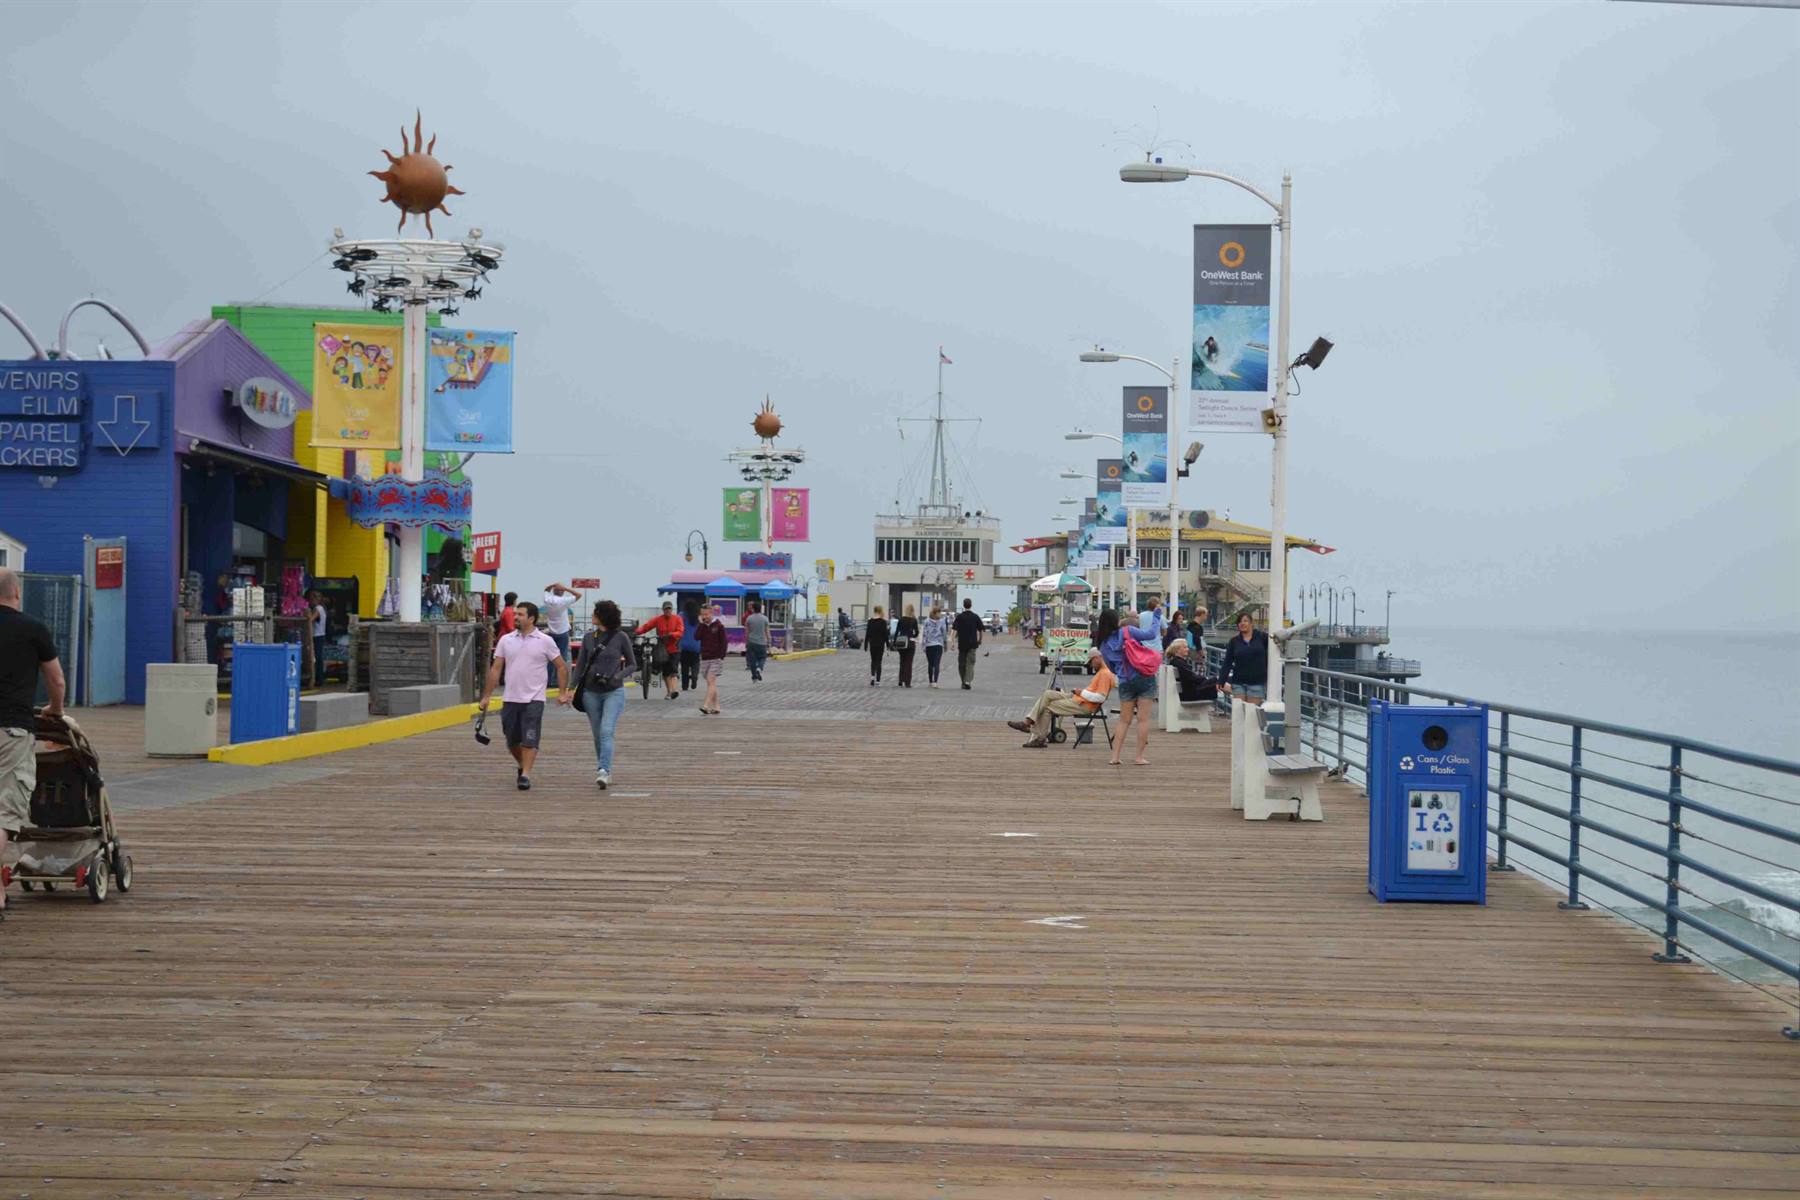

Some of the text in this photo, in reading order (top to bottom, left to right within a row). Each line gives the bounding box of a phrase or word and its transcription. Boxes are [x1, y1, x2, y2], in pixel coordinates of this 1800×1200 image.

[1200, 270, 1263, 280] OneWest Bank
[22, 396, 78, 415] FILM
[0, 422, 77, 443] PAREL
[1, 447, 78, 467] CKERS
[1049, 629, 1089, 638] DOGTOWN
[1417, 754, 1438, 763] Cans
[1430, 765, 1456, 774] Plastic
